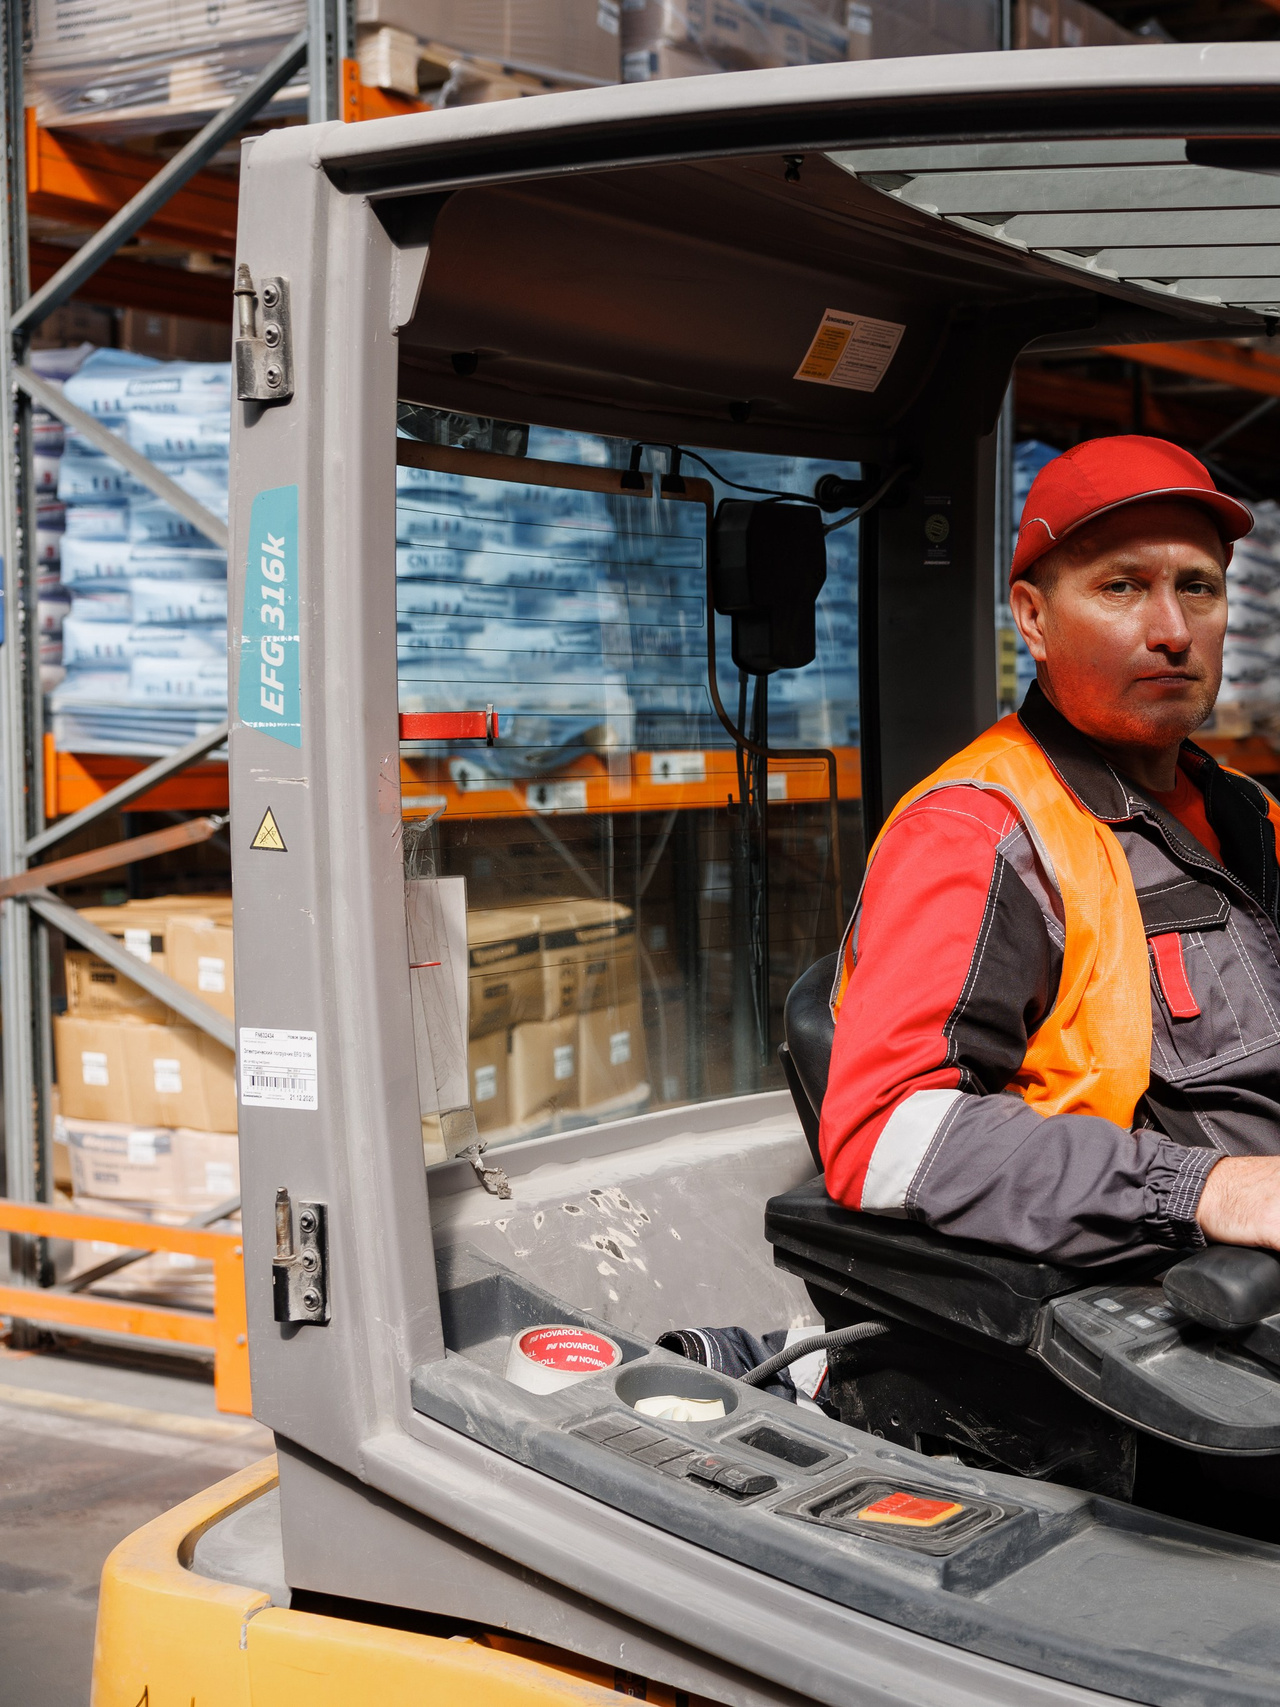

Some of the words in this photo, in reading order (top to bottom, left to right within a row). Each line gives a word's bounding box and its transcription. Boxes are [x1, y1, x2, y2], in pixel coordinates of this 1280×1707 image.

[261, 532, 285, 630] 316k
[261, 637, 284, 715] EFG
[290, 1094, 314, 1102] 21.12.2020
[540, 1329, 583, 1340] NOVAROLL
[558, 1342, 600, 1352] NOVAROLL
